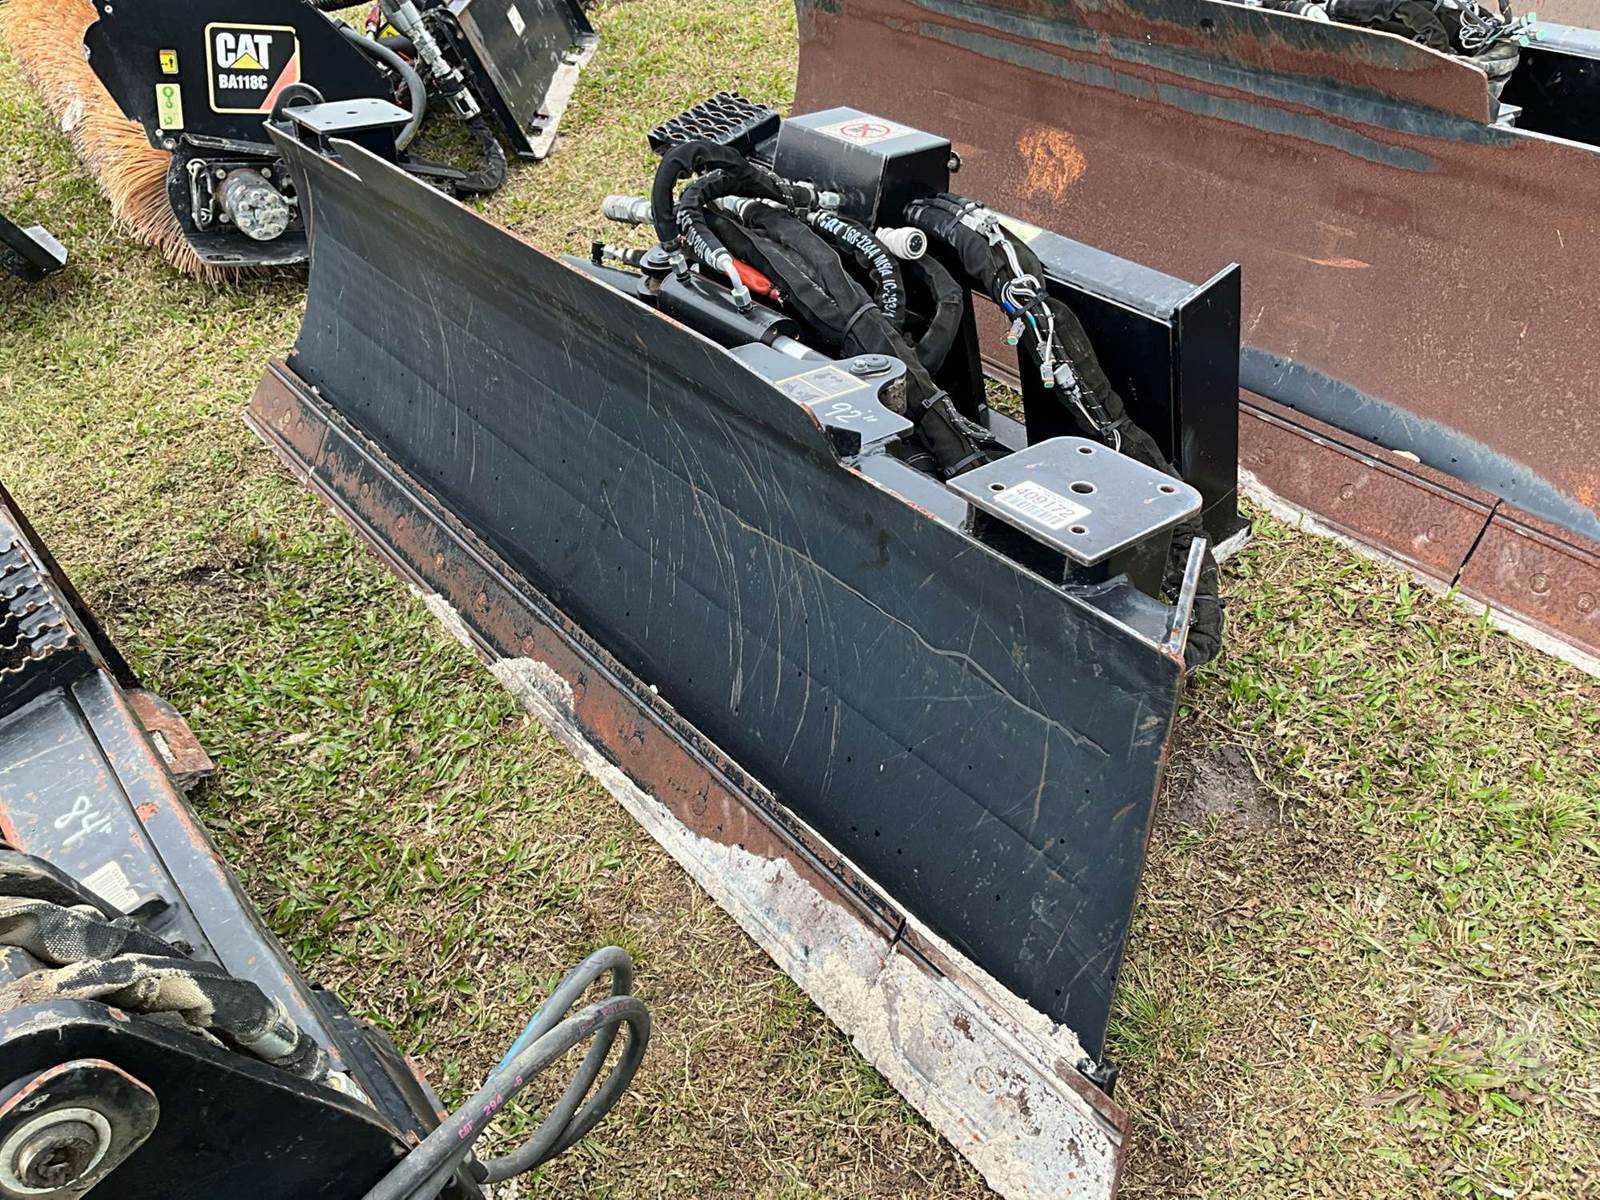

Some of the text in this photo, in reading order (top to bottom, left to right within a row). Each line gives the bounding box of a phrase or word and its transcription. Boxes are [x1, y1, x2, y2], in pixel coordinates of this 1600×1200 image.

[215, 32, 273, 70] CAT
[218, 74, 268, 90] BA118C
[1015, 488, 1076, 519] 409172
